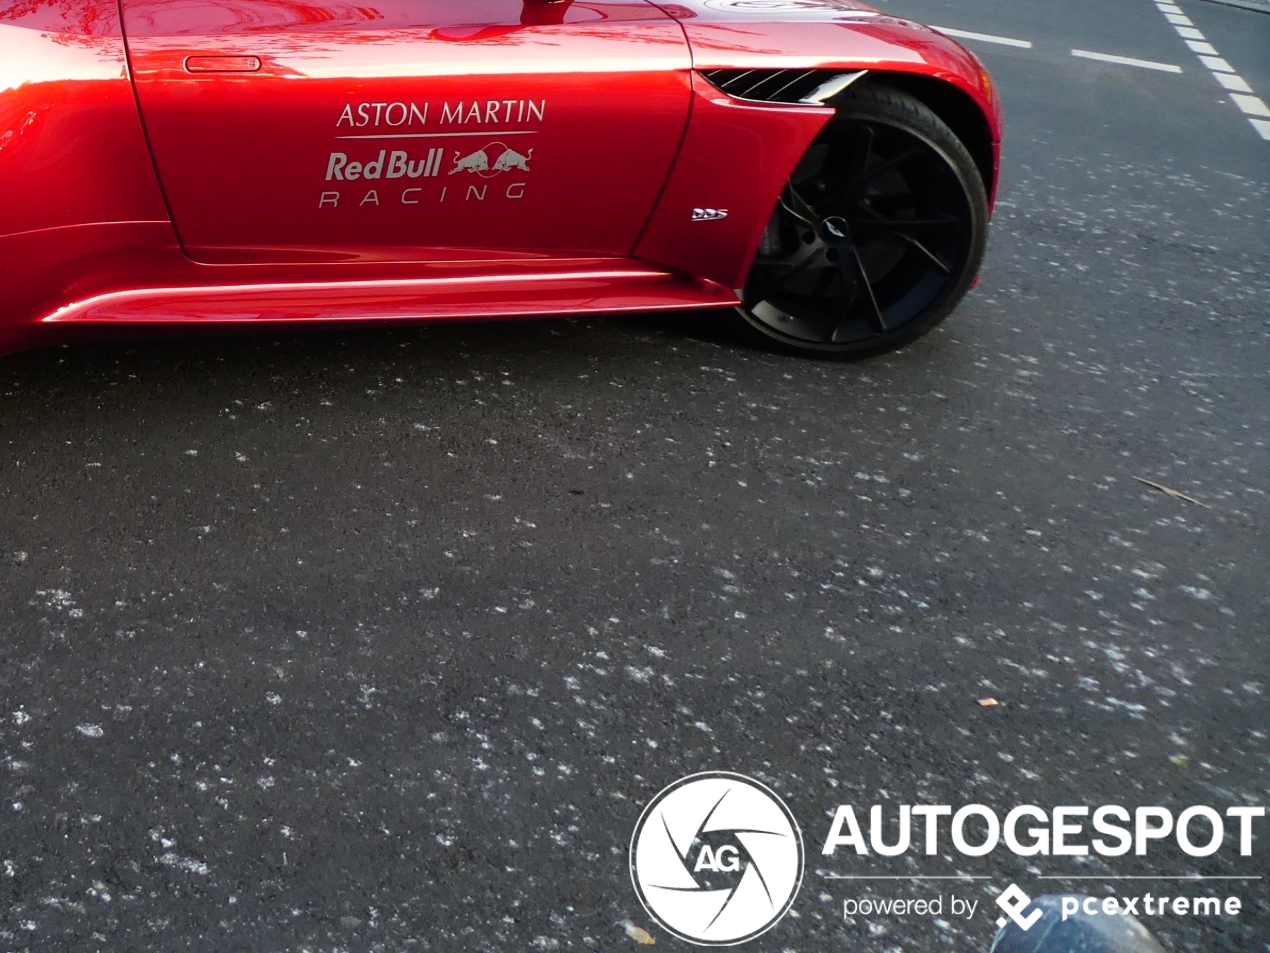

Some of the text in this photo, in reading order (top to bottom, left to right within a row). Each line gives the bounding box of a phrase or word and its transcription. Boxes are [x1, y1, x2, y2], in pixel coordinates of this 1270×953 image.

[336, 99, 546, 127] ASTON MARTIN
[318, 183, 526, 208] RACING
